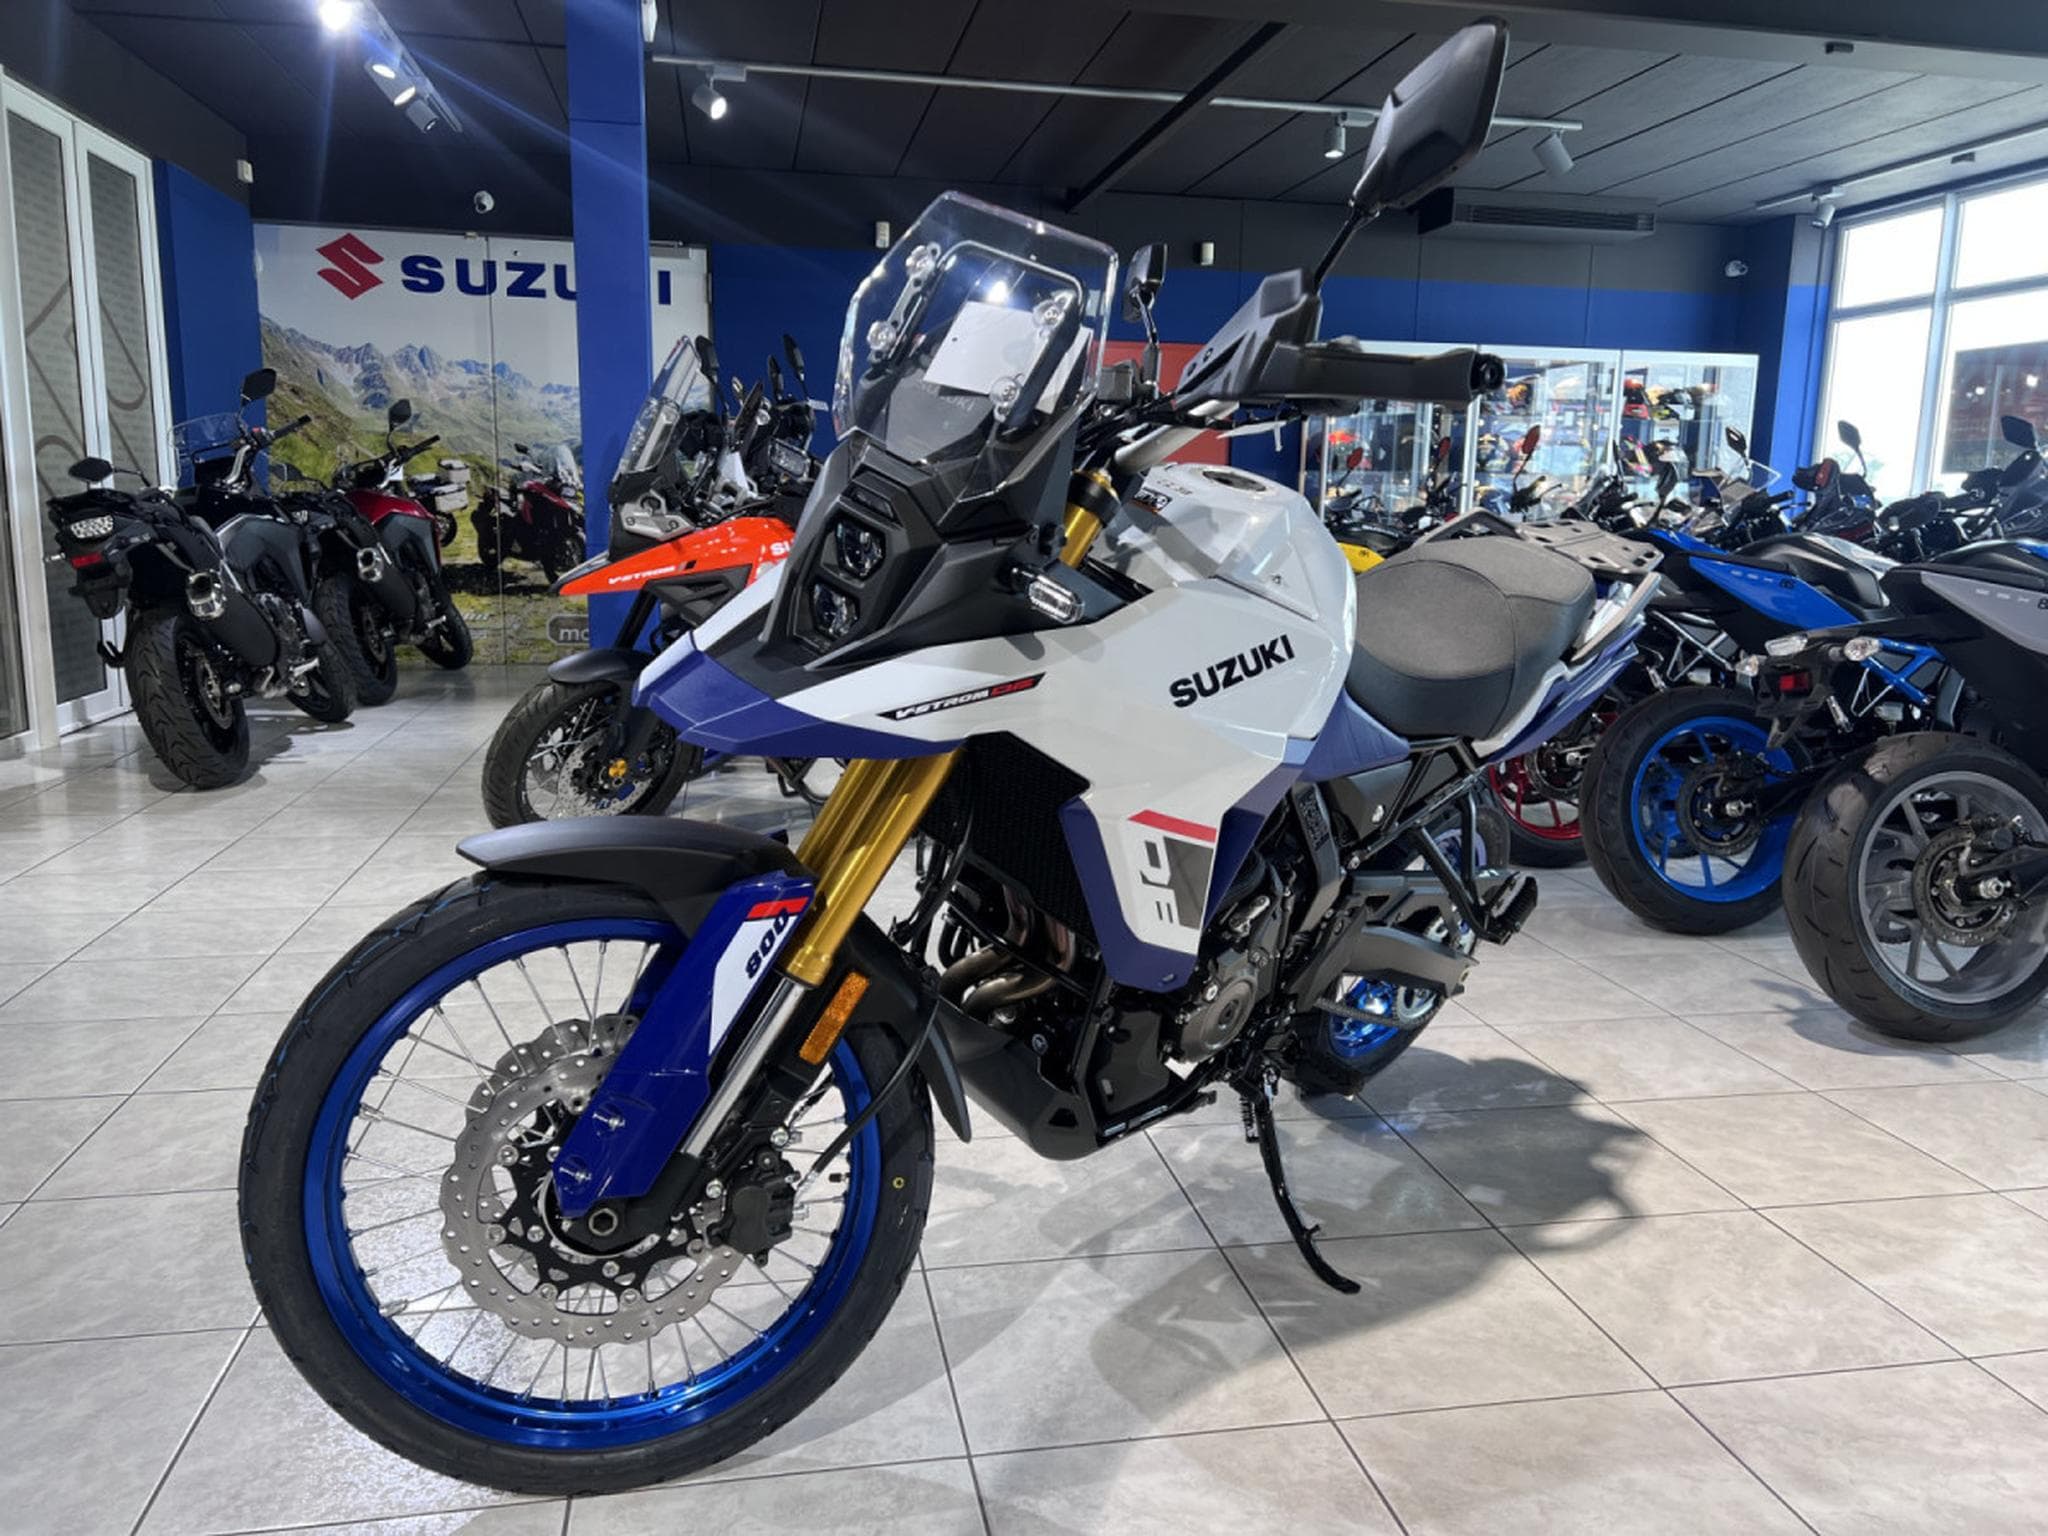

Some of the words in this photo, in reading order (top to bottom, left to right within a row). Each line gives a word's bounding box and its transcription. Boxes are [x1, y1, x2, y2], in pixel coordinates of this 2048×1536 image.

[401, 255, 671, 306] SUZUI
[1169, 634, 1295, 708] SUZUKI
[745, 907, 790, 979] 800
